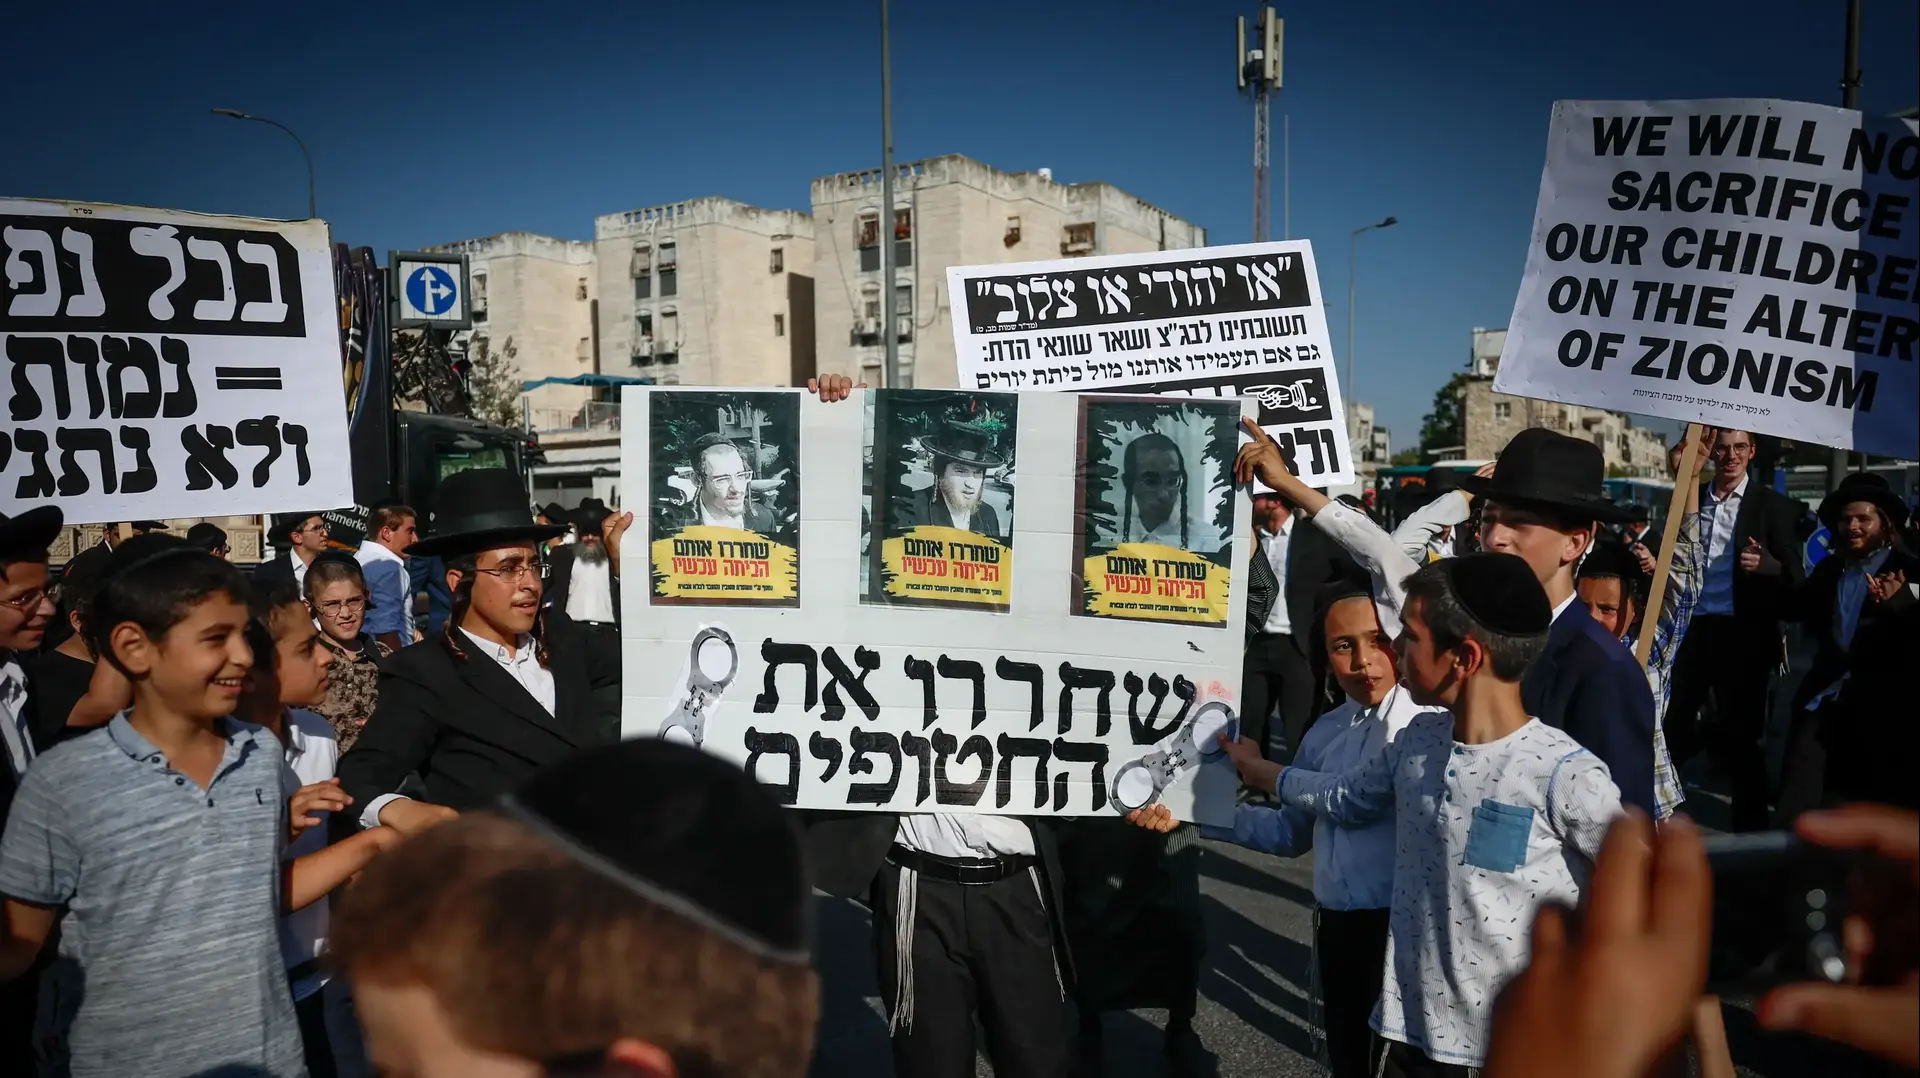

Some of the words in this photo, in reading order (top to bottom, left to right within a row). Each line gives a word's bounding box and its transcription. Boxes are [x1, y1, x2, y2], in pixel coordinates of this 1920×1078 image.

[1593, 116, 1673, 156] WE
[1689, 115, 1825, 166] WILL
[1607, 171, 1910, 240] SACRIFICE
[1545, 222, 1649, 266] OUR
[1662, 227, 1919, 303] CHILDRE
[129, 225, 289, 323] בכל
[1236, 256, 1291, 301] "או
[1086, 274, 1131, 315] או
[1139, 265, 1226, 308] יהודי
[977, 275, 1078, 323] צלוב"
[998, 324, 1017, 332] שמות
[1219, 314, 1307, 342] תשובתינו
[1547, 275, 1619, 318] ON
[1632, 280, 1735, 330] THE
[1742, 294, 1919, 362] ALTER
[1098, 328, 1152, 352] ושאר
[1157, 320, 1213, 348] לבג"צ
[982, 339, 1031, 362] הדת:
[1037, 333, 1093, 358] שונאי
[1262, 346, 1292, 363] אם
[1296, 344, 1321, 361] גם
[1086, 359, 1123, 380] מול
[1127, 356, 1182, 376] אותנו
[1186, 349, 1258, 371] תעמידו
[1557, 329, 1625, 371] OF
[1631, 335, 1879, 413] ZIONISM
[6, 335, 198, 421] נמות
[976, 370, 1027, 389] יורים
[1033, 366, 1082, 385] כיתת
[1633, 388, 1660, 398] הציונות
[1661, 391, 1683, 402] מזבח
[1684, 394, 1695, 404] על
[1697, 398, 1720, 407] ילדינו
[1720, 401, 1734, 410] את
[1735, 404, 1758, 415] נקריב
[1758, 407, 1771, 416] לא
[181, 415, 311, 490] ולא
[673, 538, 713, 557] אותם
[717, 540, 770, 560] שחררו
[903, 537, 943, 558] אותם
[948, 541, 1000, 564] שחררו
[671, 556, 718, 577] עכשיו
[901, 556, 948, 577] עכשיו
[1106, 555, 1147, 576] אותם
[1152, 559, 1207, 581] שחררו
[1104, 574, 1151, 595] עכשיו
[753, 637, 880, 721] את
[904, 654, 1196, 745] שחררו
[745, 726, 1109, 812] החטופים
